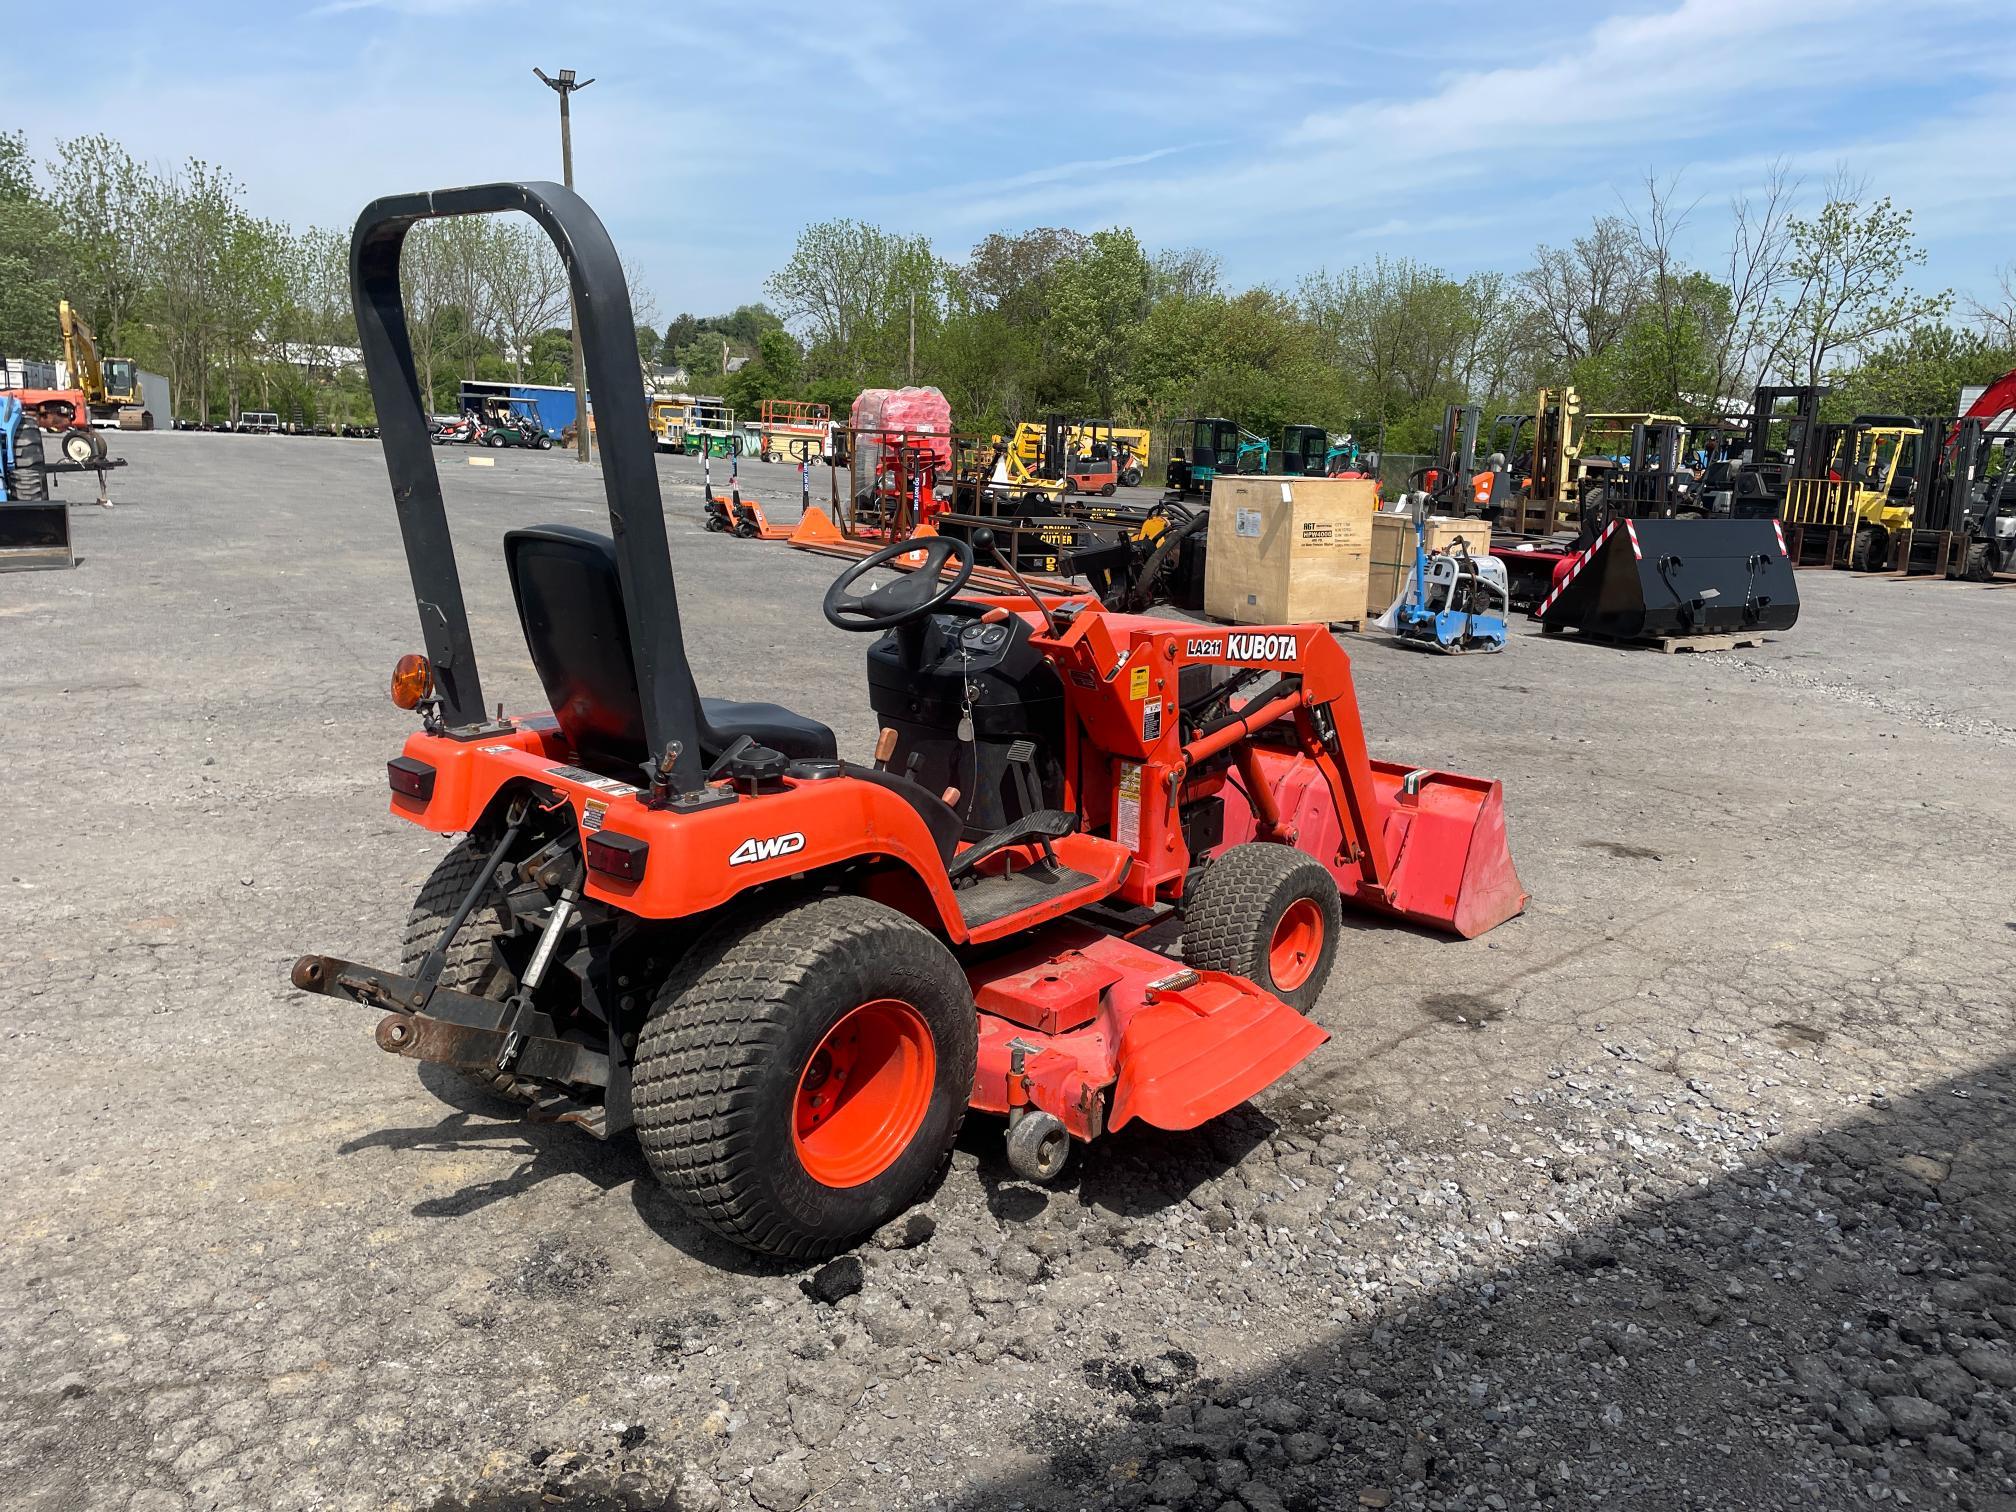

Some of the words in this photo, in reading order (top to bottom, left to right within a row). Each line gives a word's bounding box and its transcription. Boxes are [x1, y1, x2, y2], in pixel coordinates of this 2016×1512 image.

[1040, 534, 1072, 545] CUTTER
[1187, 640, 1222, 656] LA211
[1226, 633, 1297, 661] KUBOTA
[729, 832, 806, 867] 4WD
